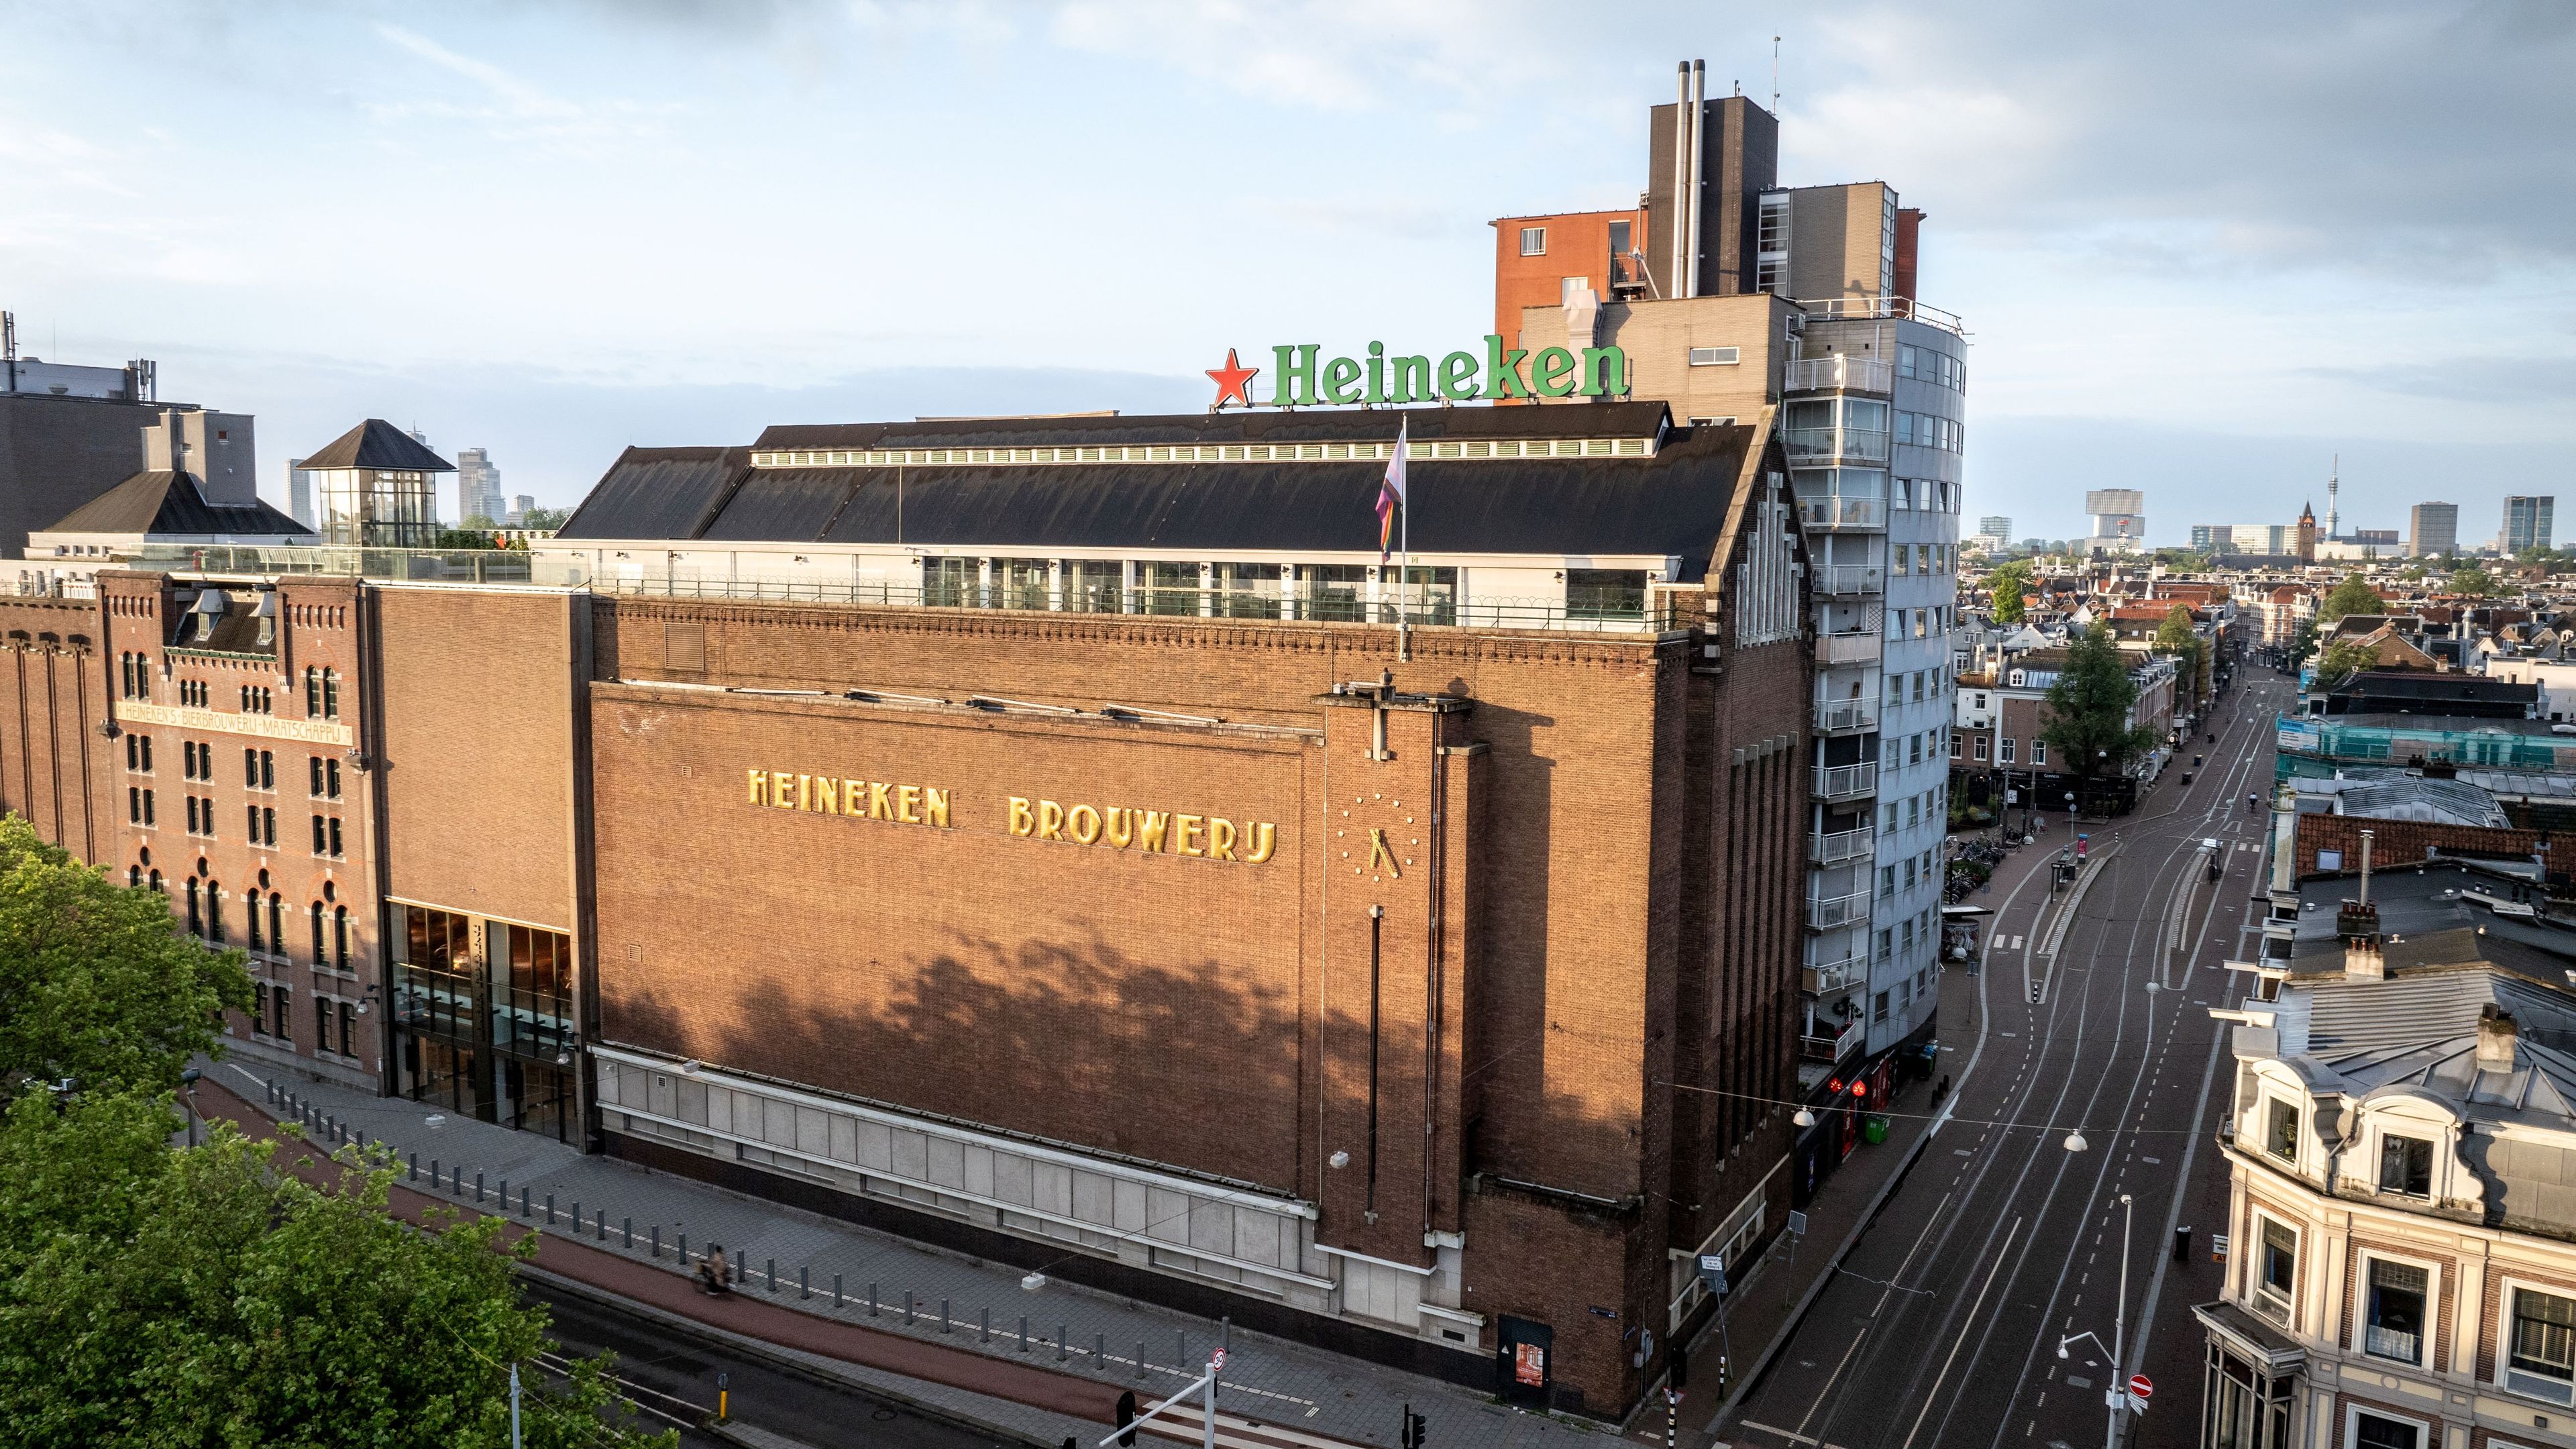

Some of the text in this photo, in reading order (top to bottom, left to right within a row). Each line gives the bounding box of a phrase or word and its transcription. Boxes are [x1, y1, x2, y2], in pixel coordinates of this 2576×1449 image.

[1272, 335, 1631, 405] Heineken
[125, 705, 340, 743] HEINEKEN'S BIERBROUWERIJ MAATSCHAPPIJ
[748, 769, 951, 828] HEINEKEN
[1215, 1354, 1224, 1364] 30
